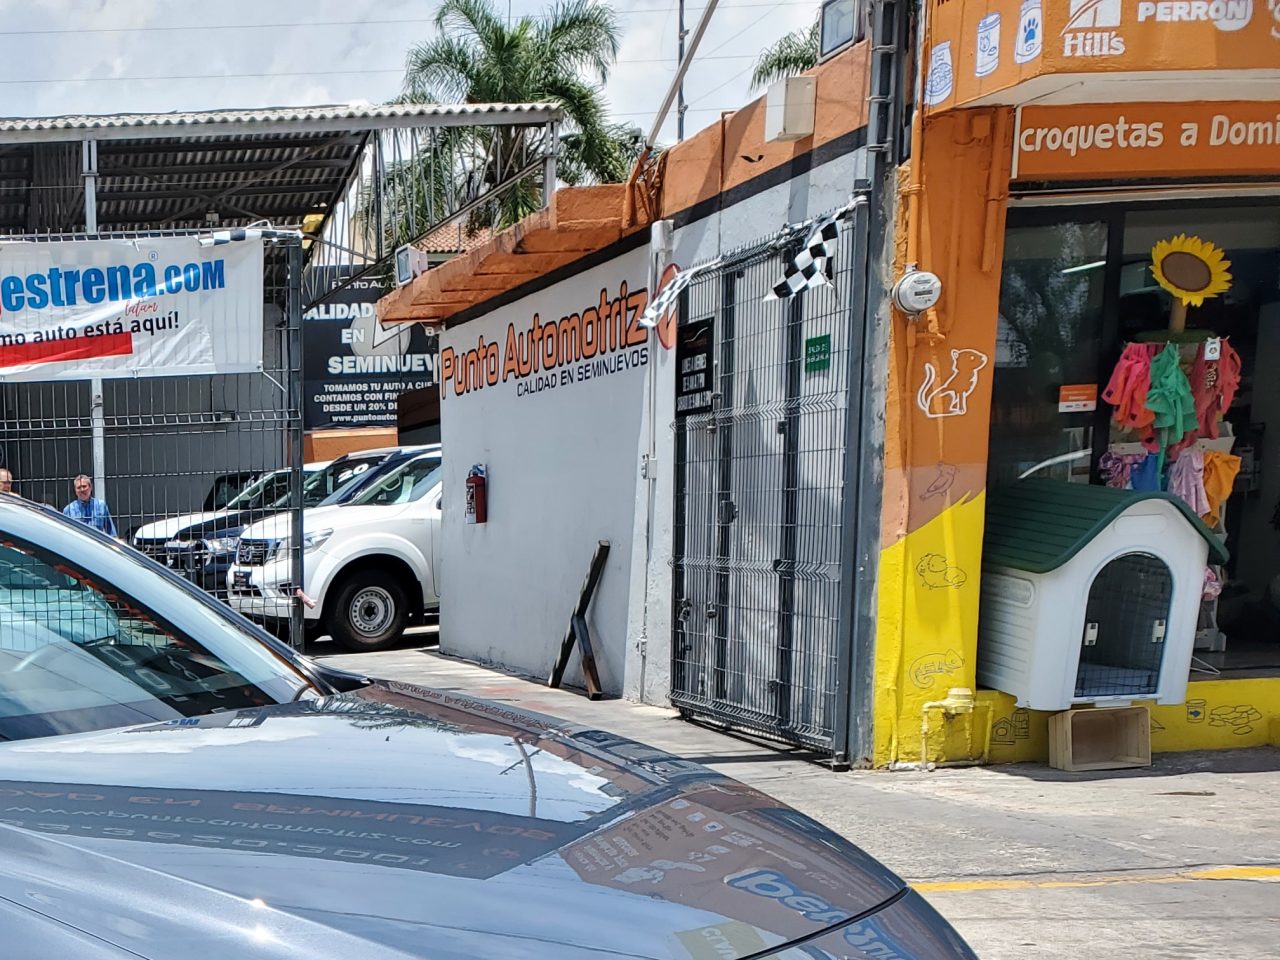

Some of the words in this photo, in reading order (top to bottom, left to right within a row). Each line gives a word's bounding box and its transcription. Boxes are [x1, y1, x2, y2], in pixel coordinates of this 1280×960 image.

[1062, 32, 1125, 57] Hill's
[1020, 116, 1164, 156] croquetas
[1180, 122, 1198, 147] a
[1209, 113, 1280, 146] Domi
[33, 325, 77, 343] auto
[83, 316, 124, 336] está
[130, 311, 179, 335] aquí!
[341, 328, 365, 344] EN
[440, 335, 500, 400] Punto
[502, 280, 649, 384] Automotriz
[327, 353, 440, 374] SEMINUEV
[517, 372, 557, 397] CALIDAD
[560, 368, 574, 386] EN
[577, 347, 649, 382] SEMINUEVOS
[314, 393, 362, 402] CONTAMOS
[364, 393, 383, 401] CON
[323, 383, 368, 392] TOMAMOS
[370, 383, 381, 391] TU
[382, 382, 406, 391] AUTO
[407, 382, 414, 390] A
[323, 403, 352, 412] DESDE
[354, 403, 366, 411] UN
[368, 402, 386, 411] 20%
